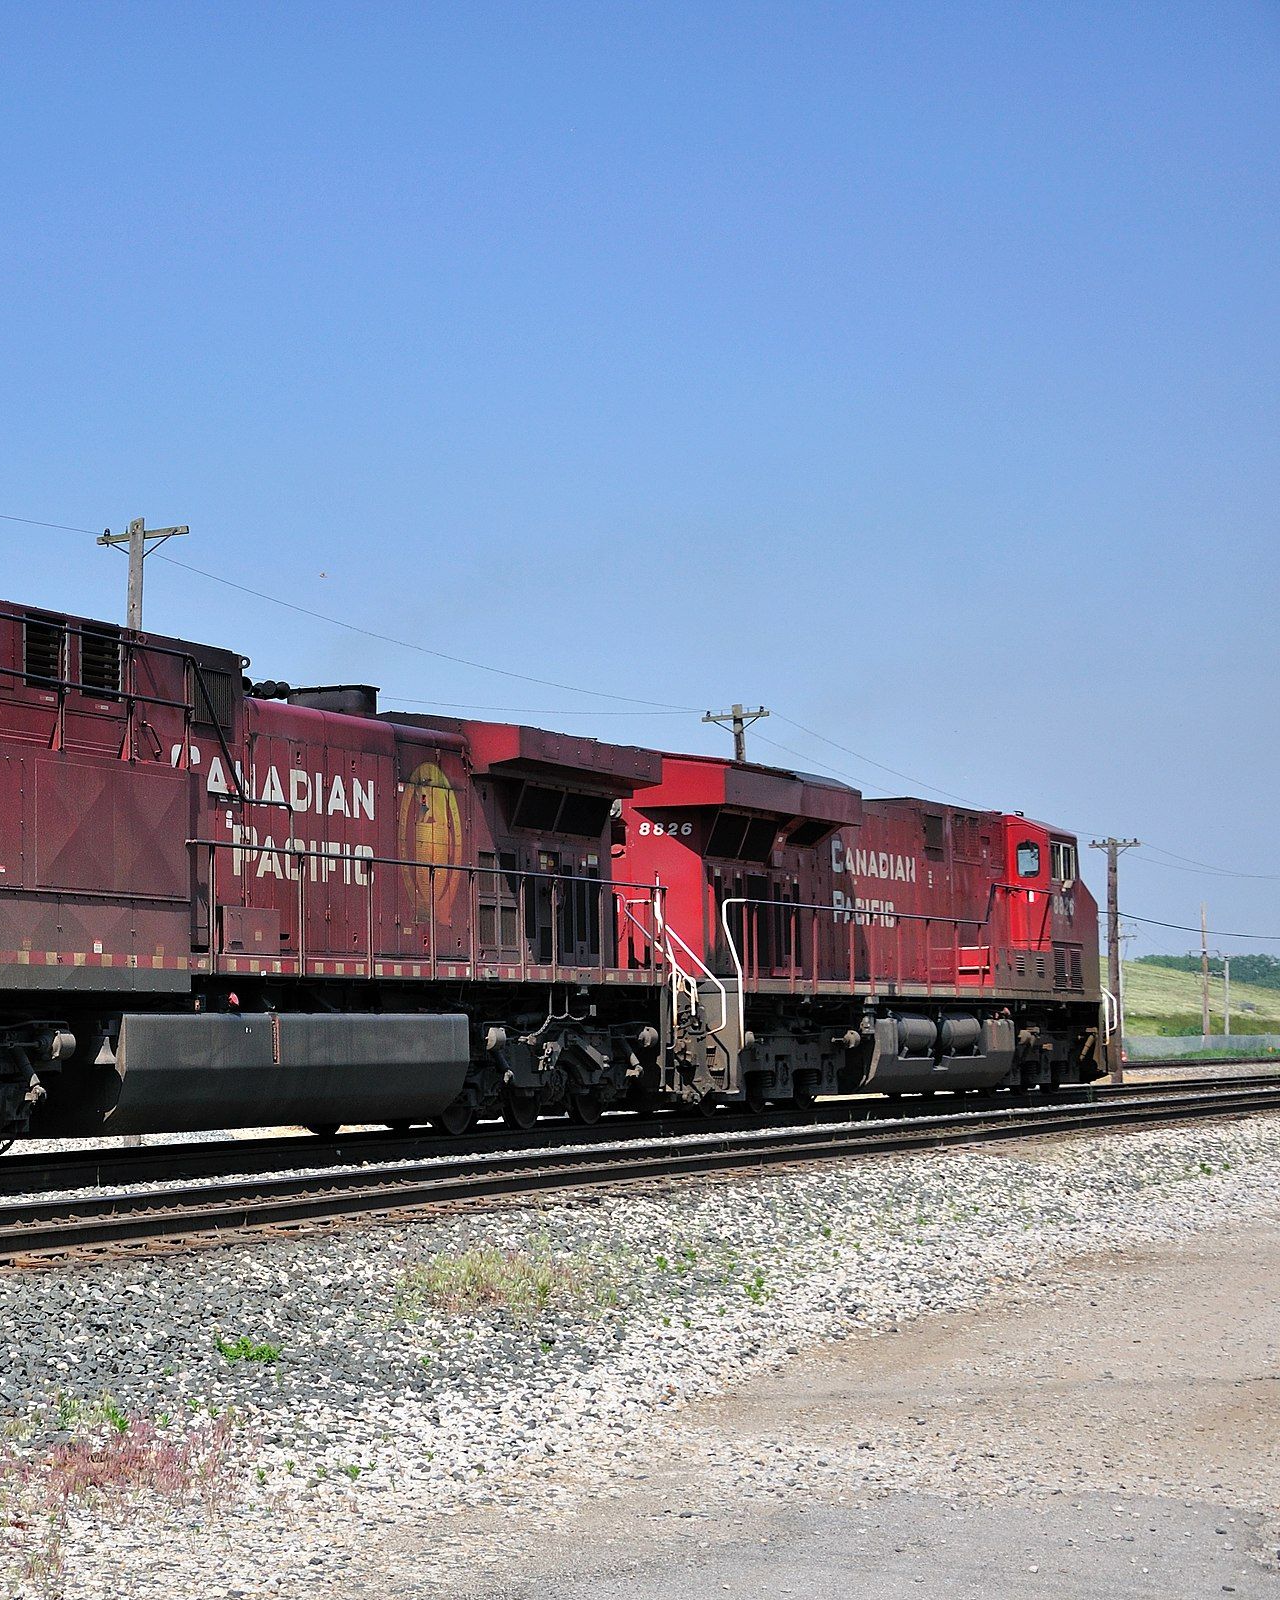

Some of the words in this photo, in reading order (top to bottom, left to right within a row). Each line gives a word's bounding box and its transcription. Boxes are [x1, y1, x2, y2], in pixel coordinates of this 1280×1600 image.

[638, 822, 693, 836] 8826
[232, 823, 375, 887] PACIFIC
[831, 840, 916, 884] CANADIAN
[832, 890, 896, 928] PACIFIC
